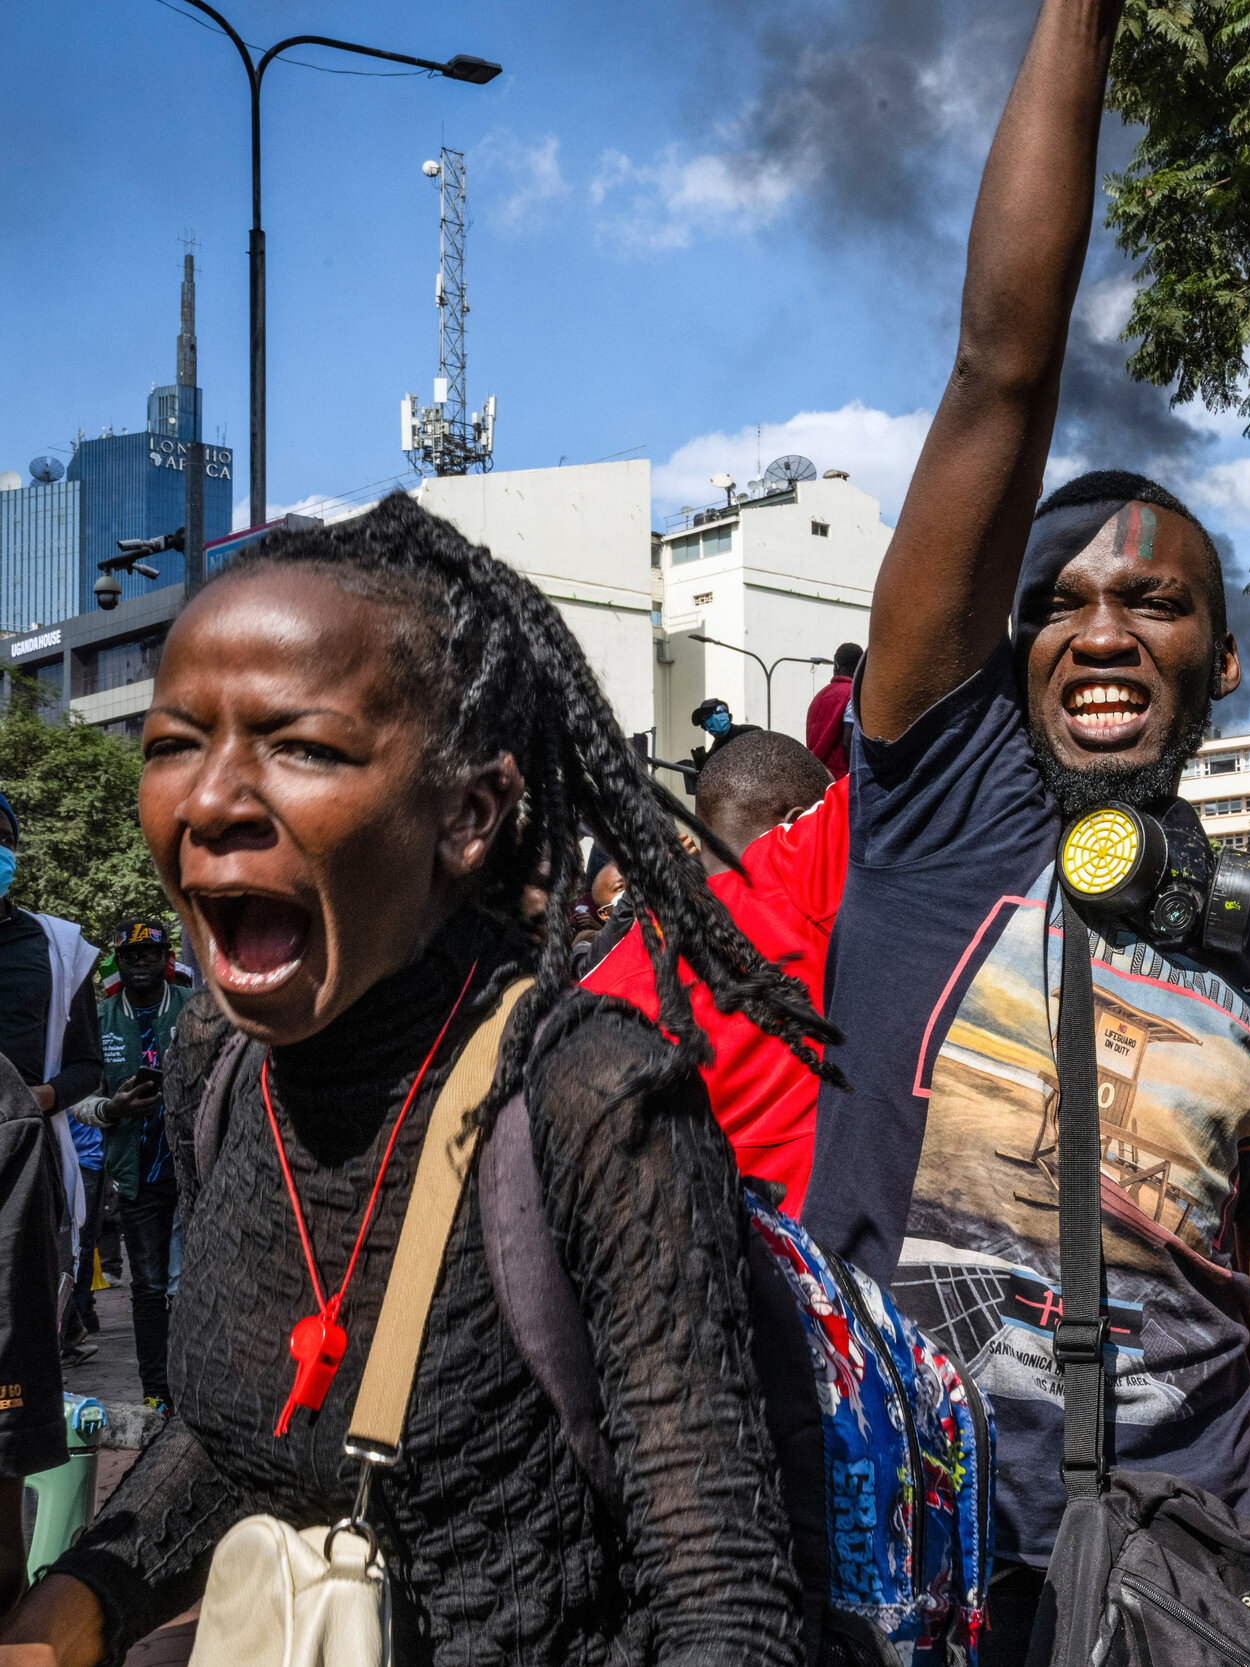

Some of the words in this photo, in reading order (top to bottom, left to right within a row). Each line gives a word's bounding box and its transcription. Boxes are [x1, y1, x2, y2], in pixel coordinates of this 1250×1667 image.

[150, 437, 231, 464] LONHO
[166, 456, 231, 480] AFCA
[11, 637, 38, 657] UGANDA
[38, 629, 61, 650] HOUSE
[1104, 1028, 1137, 1049] LIFEGUARD
[1105, 1039, 1115, 1049] ON
[1114, 1043, 1130, 1056] DUTY
[1014, 1353, 1054, 1375] MONICA
[1126, 1375, 1151, 1387] AREA
